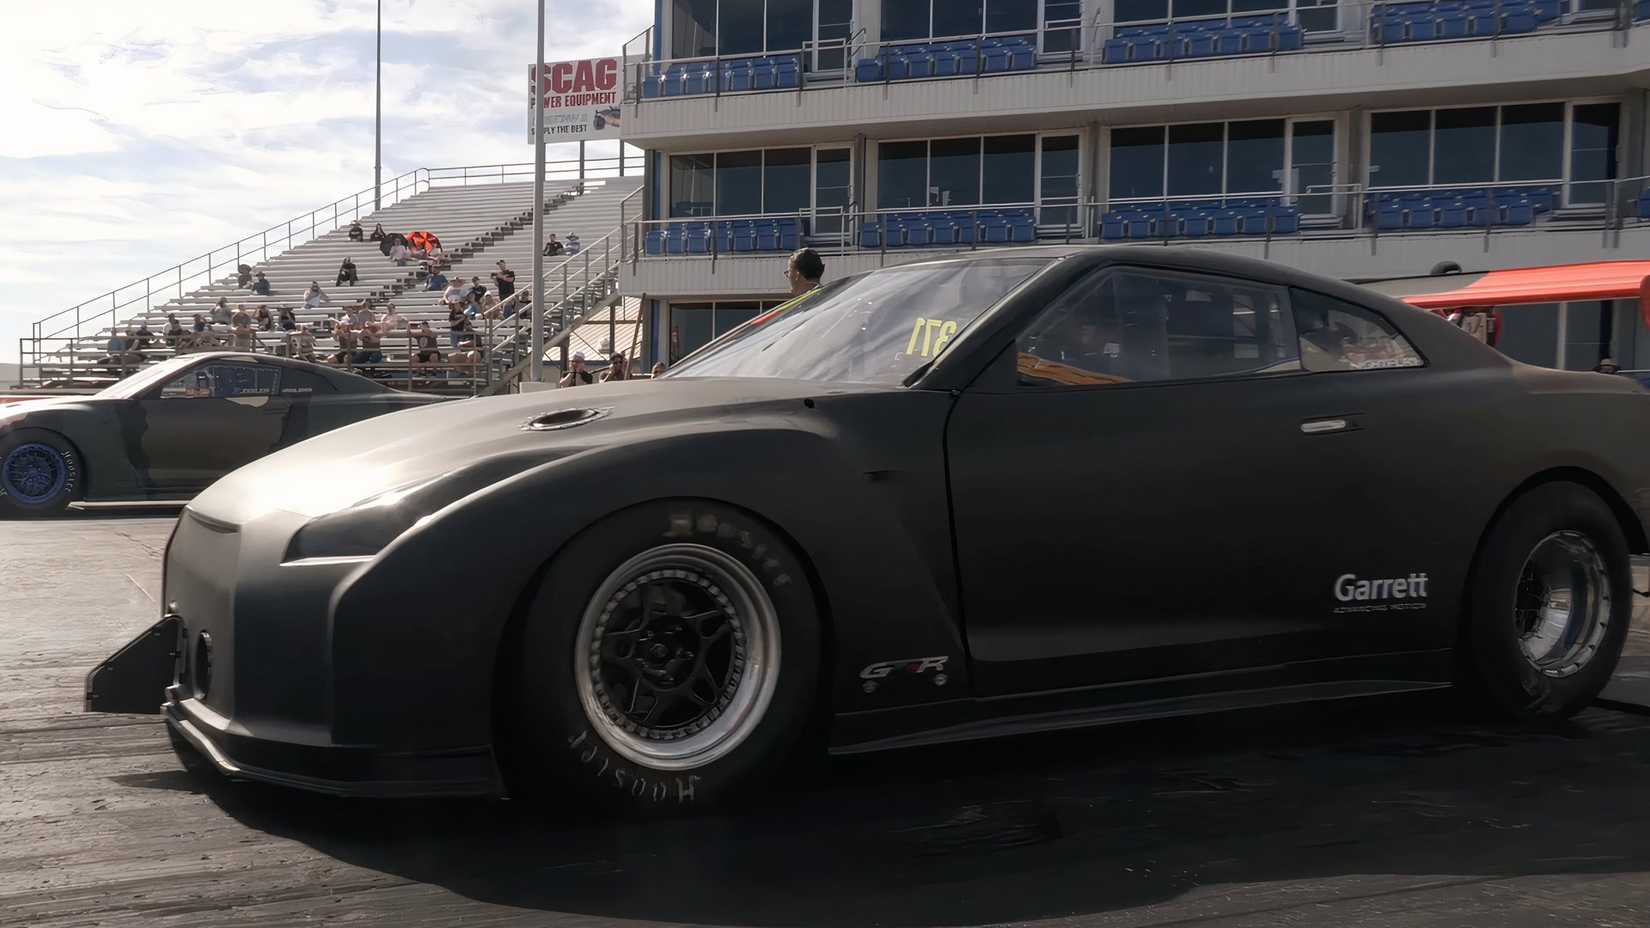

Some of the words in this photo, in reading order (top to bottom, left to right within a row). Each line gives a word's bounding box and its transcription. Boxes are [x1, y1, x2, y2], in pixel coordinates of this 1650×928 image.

[531, 58, 617, 95] SCAG
[565, 92, 616, 107] EQUIPMENT
[557, 124, 569, 134] THE
[571, 123, 587, 133] BEST
[1334, 573, 1429, 601] Garrett
